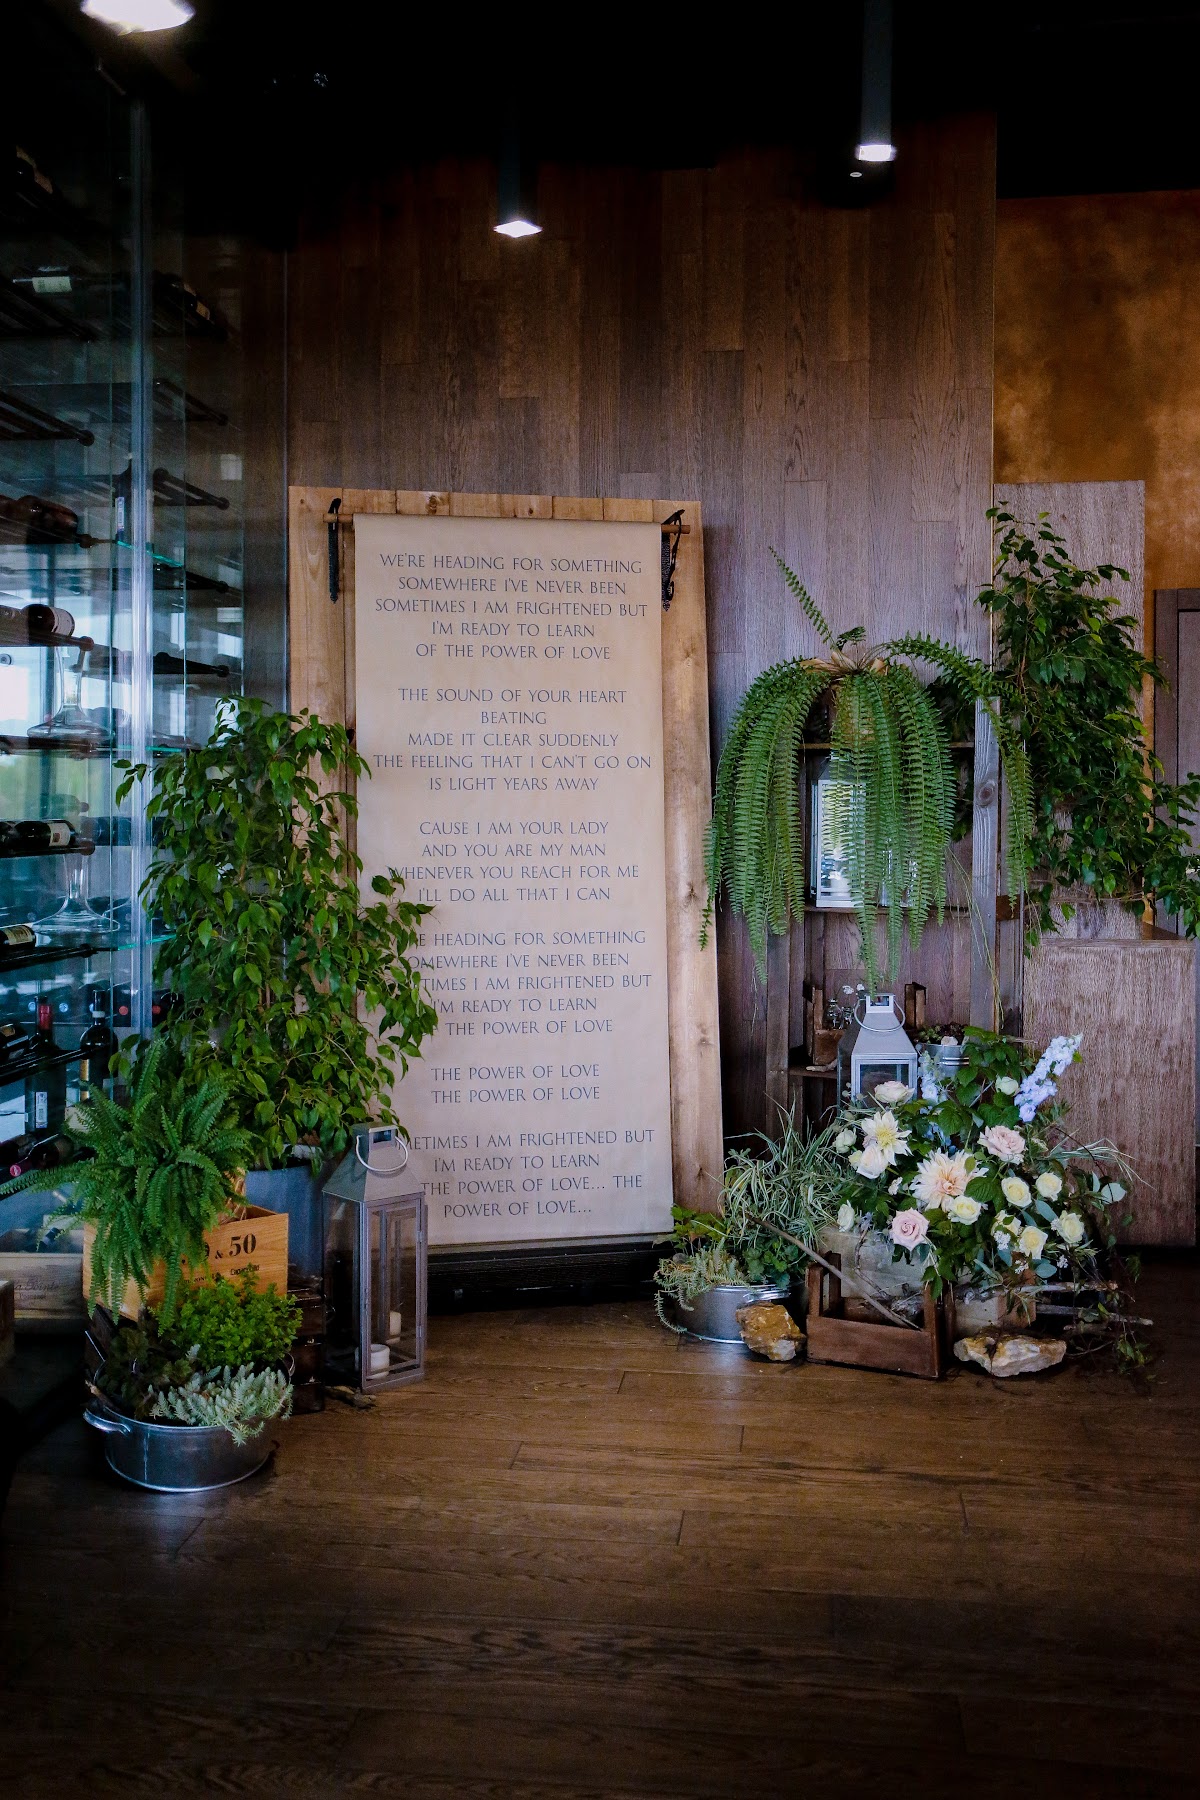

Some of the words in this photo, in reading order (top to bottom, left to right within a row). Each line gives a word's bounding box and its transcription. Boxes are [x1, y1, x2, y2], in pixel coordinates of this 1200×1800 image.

[379, 553, 426, 568] WE'RE
[433, 556, 505, 570] HEADING
[512, 558, 544, 571] FOR
[550, 559, 642, 574] SOMETHING
[398, 577, 497, 592] SOMEWHERE
[504, 578, 529, 593] I'VE
[536, 581, 584, 594] NEVER
[590, 582, 626, 595] BEEN
[375, 599, 466, 613] SOMETIMES
[472, 601, 478, 613] I
[483, 602, 509, 614] AM
[516, 602, 612, 616] FRIGHTENED
[619, 604, 648, 617] BUT
[431, 621, 453, 636] I'M
[461, 623, 511, 636] READY
[516, 624, 540, 637] TO
[547, 625, 595, 638] LEARN
[415, 644, 437, 657] OF
[443, 645, 474, 658] THE
[481, 645, 539, 659] POWER
[544, 646, 565, 659] OF
[572, 647, 611, 660] LOVE
[397, 689, 429, 702] THE
[436, 689, 494, 702] SOUND
[500, 689, 522, 703] OF
[527, 690, 573, 703] YOUR
[579, 691, 627, 704] HEART
[481, 712, 547, 725] BEATING
[408, 733, 454, 746] MADE
[461, 734, 476, 746] IT
[483, 734, 533, 747] CLEAR
[538, 734, 619, 747] SUDDENLY
[372, 755, 403, 768] THE
[411, 756, 473, 769] FEELING
[480, 756, 523, 769] THAT
[529, 756, 535, 768] I
[541, 755, 587, 769] CAN'T
[594, 756, 620, 769] GO
[626, 756, 651, 769] ON
[430, 778, 442, 791] IS
[449, 778, 497, 791] LIGHT
[503, 778, 548, 791] YEARS
[554, 778, 599, 791] AWAY
[419, 822, 469, 835] CAUSE
[476, 822, 481, 834] I
[487, 822, 513, 835] AM
[519, 822, 564, 835] YOUR
[570, 822, 609, 835] LADY
[421, 845, 457, 857] AND
[463, 844, 498, 857] YOU
[504, 844, 533, 857] ARE
[540, 844, 564, 857] MY
[570, 844, 606, 857] MAN
[386, 865, 474, 881] WHENEVER
[479, 866, 514, 880] YOU
[521, 866, 572, 879] REACH
[579, 866, 611, 879] FOR
[617, 866, 639, 878] ME
[418, 888, 442, 902] I'LL
[449, 889, 476, 902] DO
[482, 889, 510, 902] ALL
[516, 888, 559, 901] THAT
[565, 888, 570, 900] I
[576, 888, 610, 901] CAN
[434, 933, 506, 947] HEADING
[514, 933, 546, 946] FOR
[552, 931, 646, 945] SOMETHING
[400, 955, 497, 969] OMEWHERE
[506, 954, 530, 968] I'VE
[537, 954, 586, 967] NEVER
[592, 953, 629, 967] BEEN
[473, 978, 479, 990] I
[485, 978, 510, 991] AM
[518, 976, 615, 990] FRIGHTENED
[622, 975, 653, 988] BUT
[431, 999, 455, 1015] I'M
[462, 1000, 512, 1013] READY
[517, 999, 542, 1012] TO
[549, 998, 597, 1012] LEARN
[444, 1023, 475, 1036] THE
[483, 1021, 540, 1035] POWER
[546, 1021, 567, 1034] OF
[574, 1020, 613, 1033] LOVE
[430, 1068, 461, 1081] THE
[469, 1066, 526, 1080] POWER
[532, 1066, 554, 1079] OF
[561, 1064, 600, 1078] LOVE
[430, 1090, 461, 1104] THE
[469, 1089, 527, 1103] POWER
[532, 1088, 554, 1101] OF
[561, 1087, 600, 1101] LOVE
[474, 1136, 480, 1147] I
[486, 1135, 512, 1148] AM
[519, 1131, 618, 1147] FRIGHTENED
[625, 1130, 655, 1144] BUT
[434, 1158, 456, 1173] I'M
[463, 1157, 514, 1172] READY
[520, 1156, 544, 1170] TO
[551, 1154, 600, 1169] LEARN
[420, 1181, 451, 1197] THE
[458, 1180, 517, 1195] POWER
[522, 1179, 544, 1193] OF
[551, 1177, 605, 1192] LOVE...
[612, 1175, 642, 1189] THE
[443, 1203, 502, 1219] POWER
[508, 1202, 529, 1216] OF
[537, 1200, 592, 1215] LOVE...
[215, 1250, 223, 1259] &
[229, 1233, 257, 1256] 50
